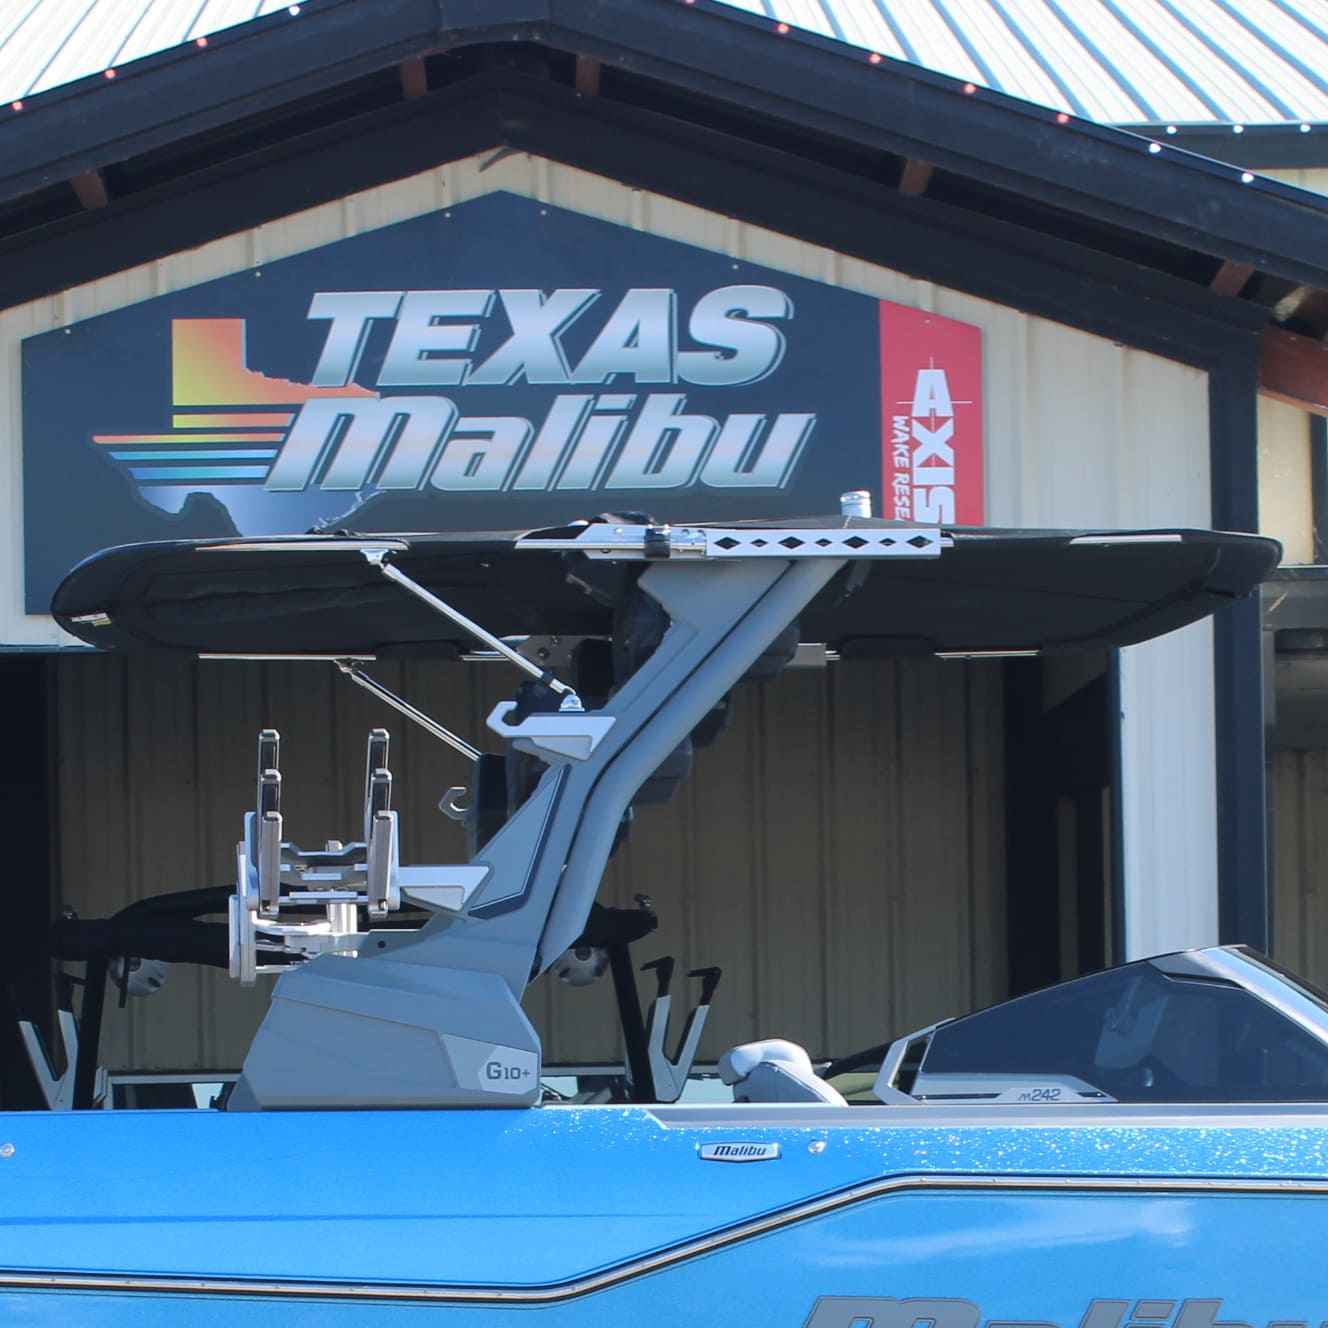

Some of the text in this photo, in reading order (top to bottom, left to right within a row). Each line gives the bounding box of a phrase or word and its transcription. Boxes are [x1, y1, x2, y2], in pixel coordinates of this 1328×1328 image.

[307, 285, 794, 387] TEXAS
[264, 394, 816, 492] Malibu
[892, 416, 909, 468] WAKE
[911, 369, 955, 524] AXIS
[486, 1062, 530, 1080] G10+
[713, 1145, 768, 1157] Malibu
